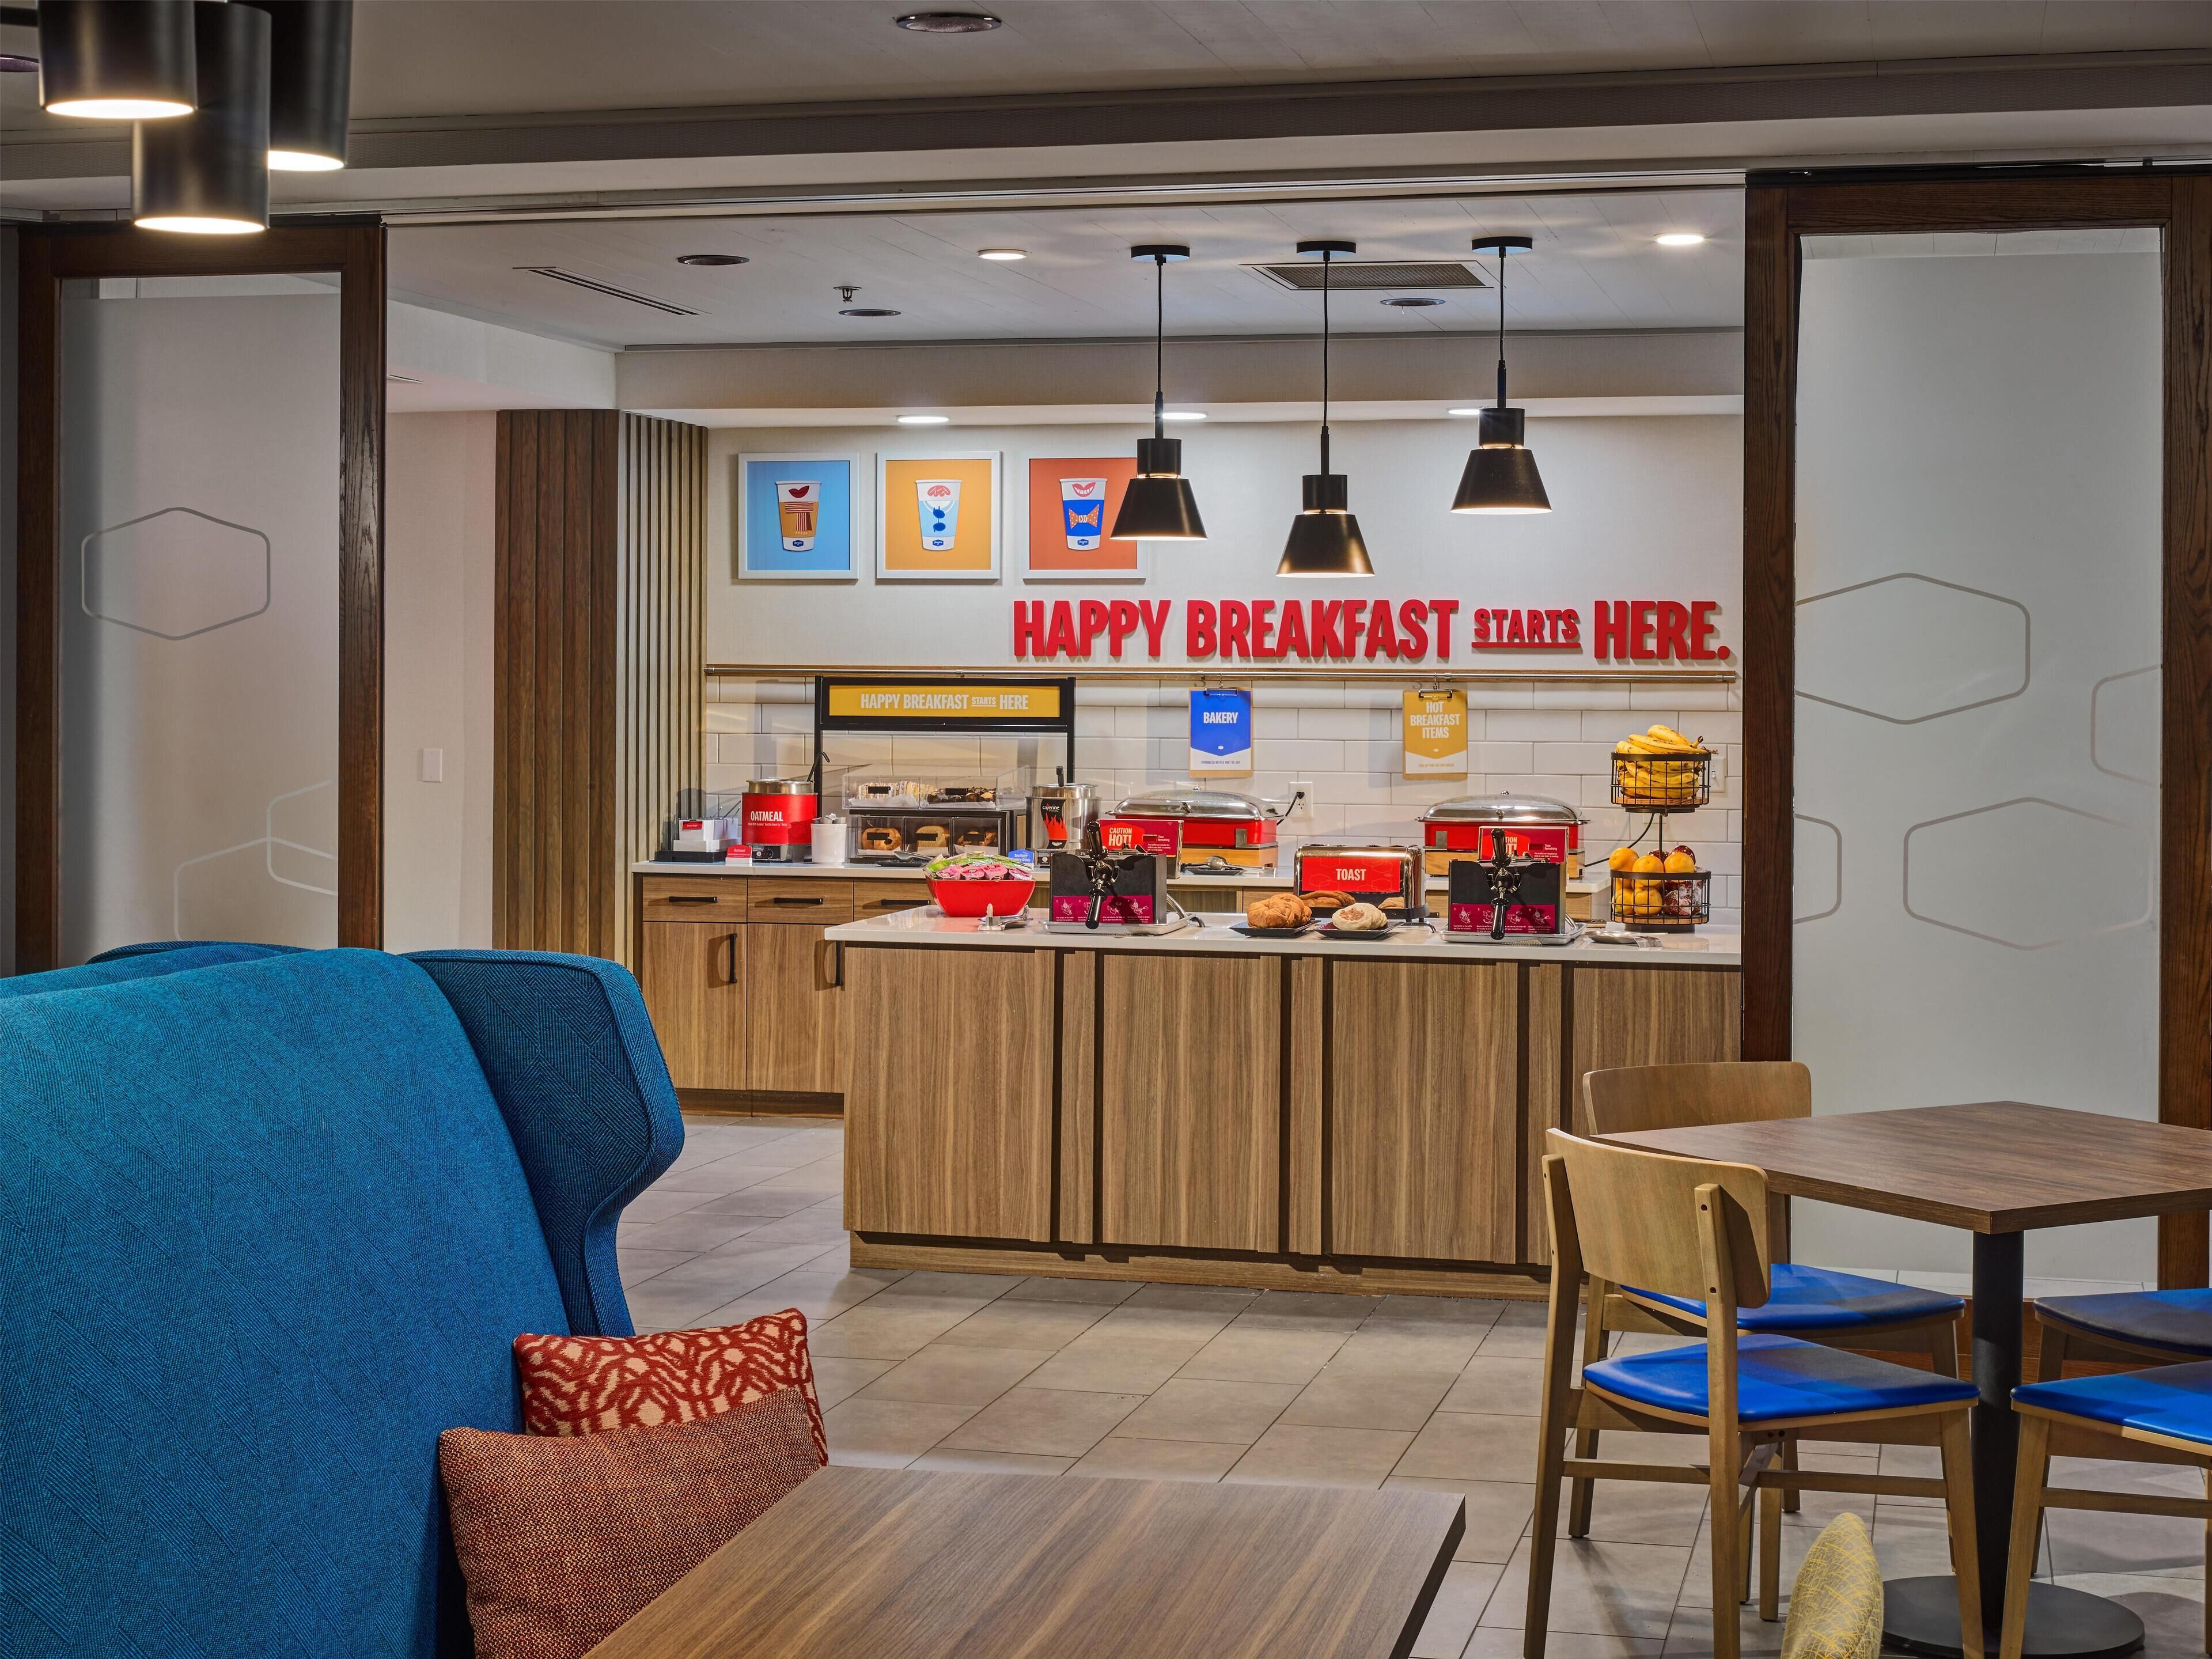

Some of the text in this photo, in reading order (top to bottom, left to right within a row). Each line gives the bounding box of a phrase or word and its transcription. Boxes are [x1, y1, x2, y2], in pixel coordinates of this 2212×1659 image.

[1013, 599, 1730, 660] HAPPY BREAKFAST STARTS HERE.
[861, 693, 1029, 710] HAPPY BREAKFAST STARTS HERE
[1426, 702, 1444, 713] HOT
[1203, 712, 1238, 724] BAKERY
[1410, 714, 1461, 726] BREAKFAST
[1422, 727, 1449, 738] ITEMS
[751, 810, 784, 822] OATMEAL
[1108, 834, 1132, 847] HOT!
[1336, 868, 1366, 881] TOAST
